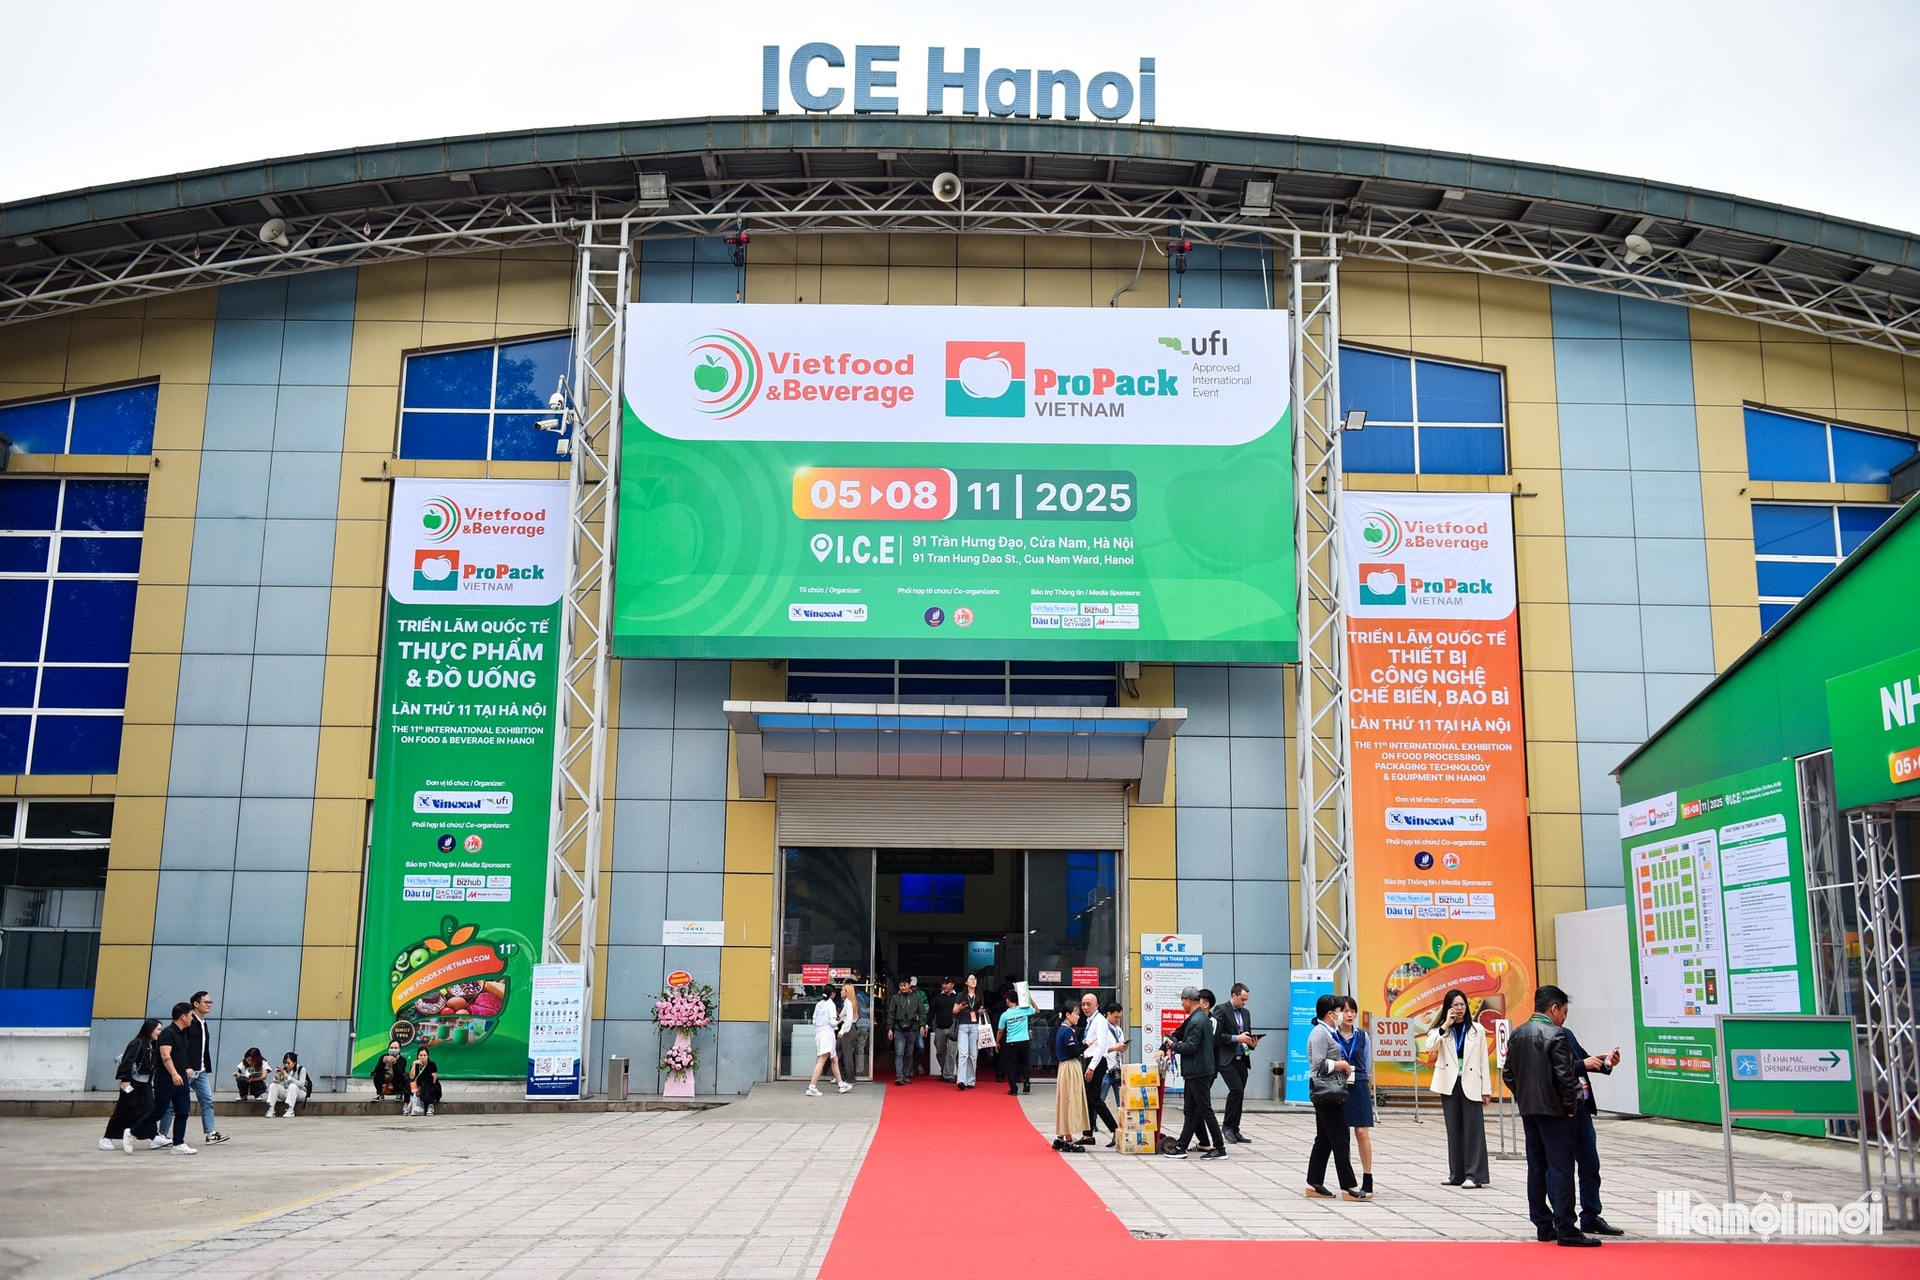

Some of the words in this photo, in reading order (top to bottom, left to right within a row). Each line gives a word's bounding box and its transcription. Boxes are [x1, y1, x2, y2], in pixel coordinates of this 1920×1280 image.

[762, 42, 899, 114] ICE
[927, 47, 1155, 121] Hanoi
[1192, 330, 1227, 356] ufi
[768, 352, 914, 375] Vietfood
[1192, 362, 1240, 374] Approved
[1034, 368, 1178, 396] ProPack
[1192, 375, 1252, 386] International
[766, 379, 914, 408] &Beverage
[1193, 387, 1219, 398] Event
[1035, 402, 1125, 418] VIETNAM
[811, 480, 860, 509] 05
[886, 481, 938, 510] 08
[967, 482, 1001, 511] 11
[1035, 483, 1131, 512] 2025
[464, 508, 546, 521] Vietfood
[462, 522, 545, 538] &Beverage
[1404, 520, 1488, 534] Vietfood
[837, 535, 894, 564] I.C.E
[912, 536, 928, 548] 91
[930, 534, 959, 549] Trần
[962, 536, 996, 551] Hưng
[998, 536, 1027, 552] Đạo,
[1029, 535, 1056, 550] Cửa
[1058, 536, 1091, 552] Nam,
[1094, 536, 1111, 550] Hà
[1112, 536, 1134, 551] Nội
[1405, 536, 1489, 551] &Beverage
[912, 553, 926, 564] 91
[927, 553, 950, 564] Tran
[952, 554, 980, 567] Hung
[982, 554, 1003, 565] Dao
[1024, 554, 1044, 566] Cua
[1046, 555, 1071, 566] Nam
[1073, 555, 1102, 567] Ward,
[1104, 555, 1134, 566] Hanoi
[463, 564, 544, 580] ProPack
[463, 582, 513, 591] VIETNAM
[830, 588, 862, 597] Organizer:
[954, 588, 1001, 598] Co-organizers:
[1410, 578, 1493, 594] ProPack
[1090, 590, 1108, 598] Media
[1110, 590, 1142, 599] Sponsors:
[1411, 596, 1463, 606] VIETNAM
[398, 616, 441, 632] TRIỂN
[444, 618, 478, 633] LÃM
[482, 618, 527, 634] QUỐC
[530, 618, 550, 634] TẾ
[1348, 628, 1394, 644] TRIỂN
[1398, 628, 1433, 644] LÃM
[1436, 630, 1483, 645] QUỐC
[1486, 630, 1507, 646] TẾ
[398, 642, 468, 665] THỰC
[472, 637, 544, 661] PHẨM
[1388, 646, 1445, 664] THIẾT
[1449, 650, 1467, 669] BỊ
[406, 669, 422, 688] &
[426, 664, 462, 688] ĐỒ
[468, 664, 536, 689] UỐNG
[1370, 665, 1429, 684] CÔNG
[1432, 666, 1486, 689] NGHỆ
[1350, 684, 1390, 703] CHẾ
[1394, 685, 1442, 708] BIẾN,
[1446, 689, 1487, 705] BAO
[1492, 686, 1509, 705] BÌ
[392, 700, 421, 715] LẦN
[424, 701, 456, 716] THỨ
[458, 704, 470, 716] 11
[474, 704, 496, 719] TẠI
[498, 702, 519, 716] HÀ
[522, 702, 547, 719] NỘI
[425, 726, 494, 734] INTERNATIONAL
[496, 727, 544, 735] EXHIBITION
[1350, 714, 1380, 730] LẦN
[1382, 716, 1415, 730] THỨ
[1418, 719, 1431, 731] 11
[1435, 720, 1458, 734] TẠI
[1461, 717, 1483, 731] HÀ
[1485, 717, 1511, 735] NỘI
[401, 736, 414, 744] ON
[416, 736, 441, 744] FOOD
[442, 736, 448, 744] &
[450, 736, 495, 744] BEVERAGE
[506, 737, 535, 745] HANOI
[1354, 741, 1371, 749] THE
[1389, 742, 1460, 750] INTERNATIONAL
[1462, 743, 1513, 751] EXHIBITION
[1382, 752, 1395, 760] ON
[1424, 753, 1484, 762] PROCESSING,
[1374, 763, 1427, 771] PACKAGING
[1430, 763, 1491, 772] TECHNOLOGY
[1895, 757, 1911, 777] 05
[1384, 773, 1390, 781] &
[1391, 773, 1445, 781] EQUIPMENT
[1456, 774, 1486, 782] HANOI
[1710, 798, 1723, 809] 2025
[1156, 943, 1186, 953] I.C.E
[396, 954, 490, 1001] WWW.FOODEXVIETNAM.COM
[1447, 979, 1459, 988] AND
[1460, 974, 1486, 984] PROPACK
[1377, 1022, 1408, 1035] STOP
